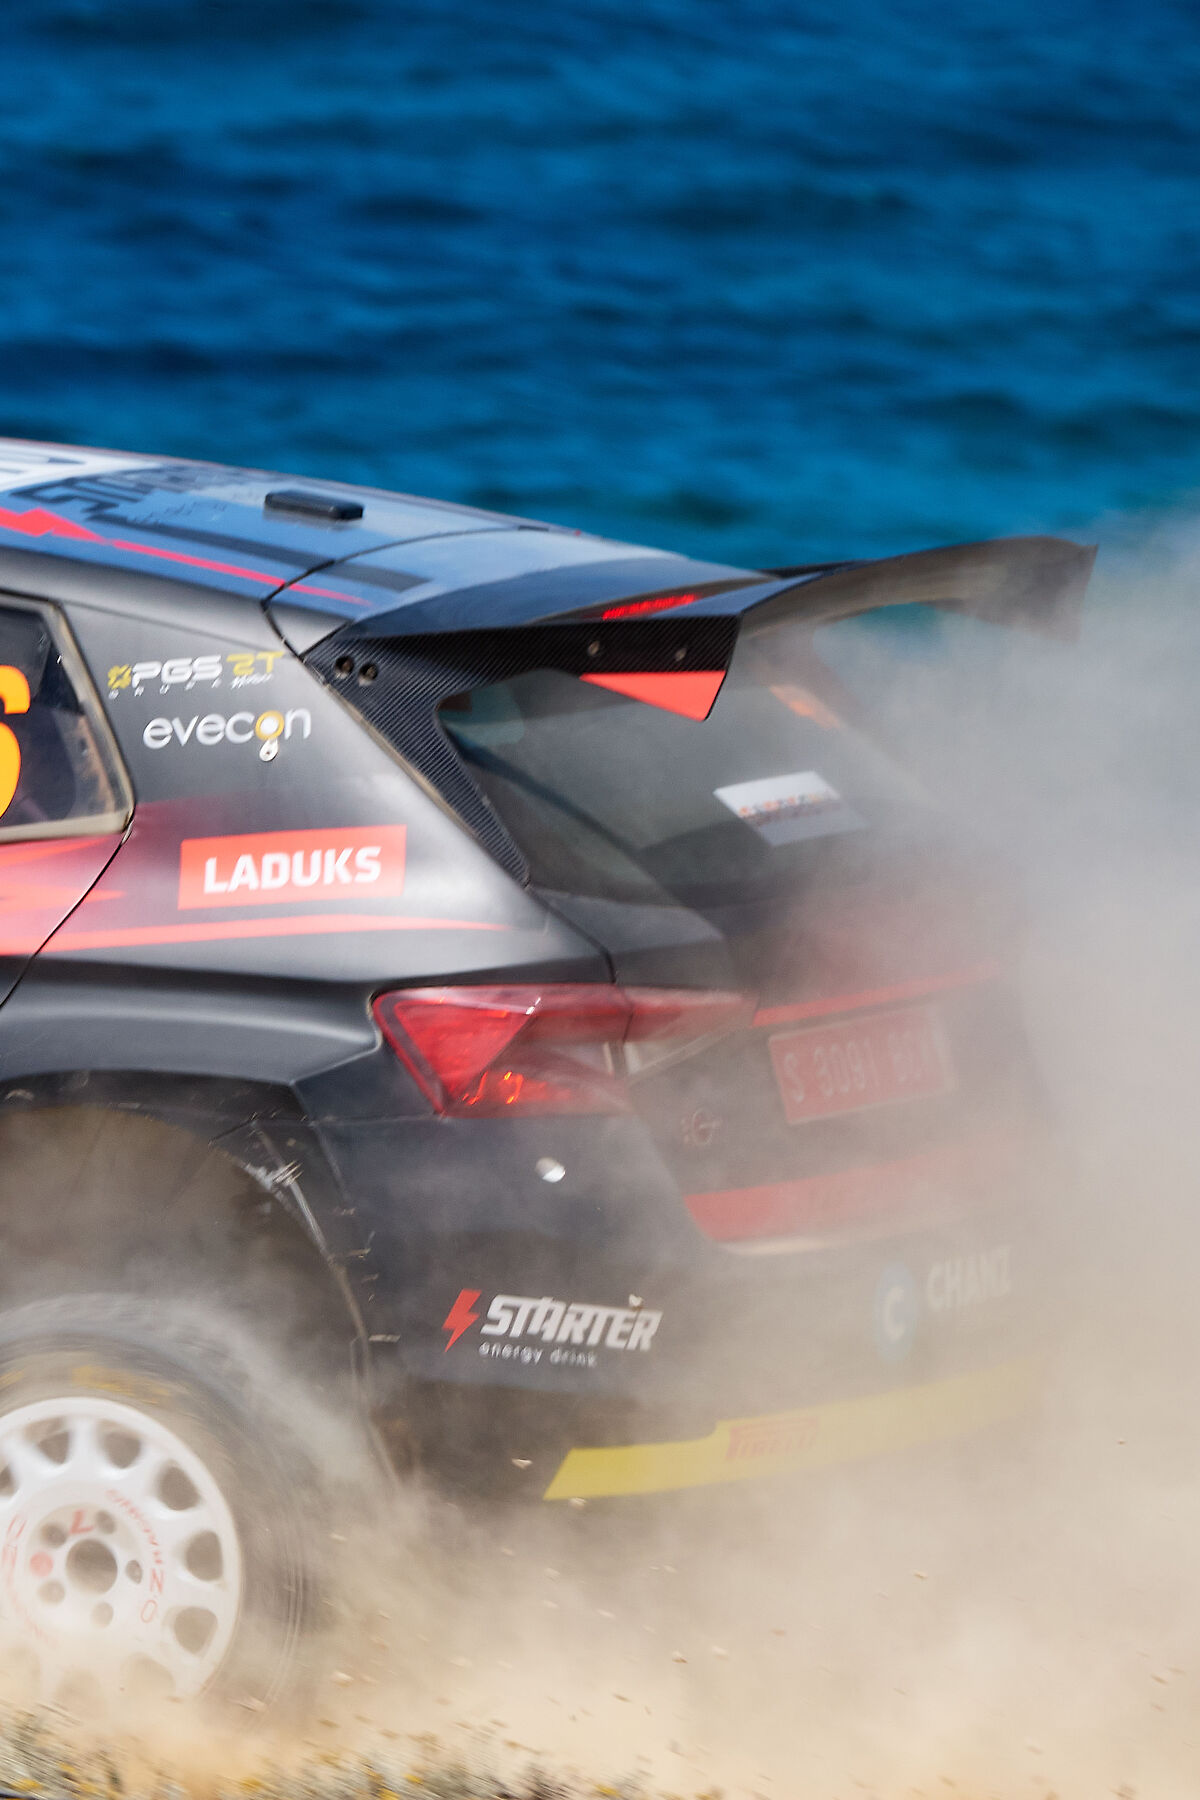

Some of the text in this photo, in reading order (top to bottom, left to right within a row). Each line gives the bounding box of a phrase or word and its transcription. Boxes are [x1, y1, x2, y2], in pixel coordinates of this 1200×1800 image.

[132, 655, 222, 688] PGS
[143, 708, 311, 750] evecon
[204, 847, 381, 894] LADUKS
[480, 1294, 664, 1351] STARTER
[478, 1341, 598, 1368] energy drink
